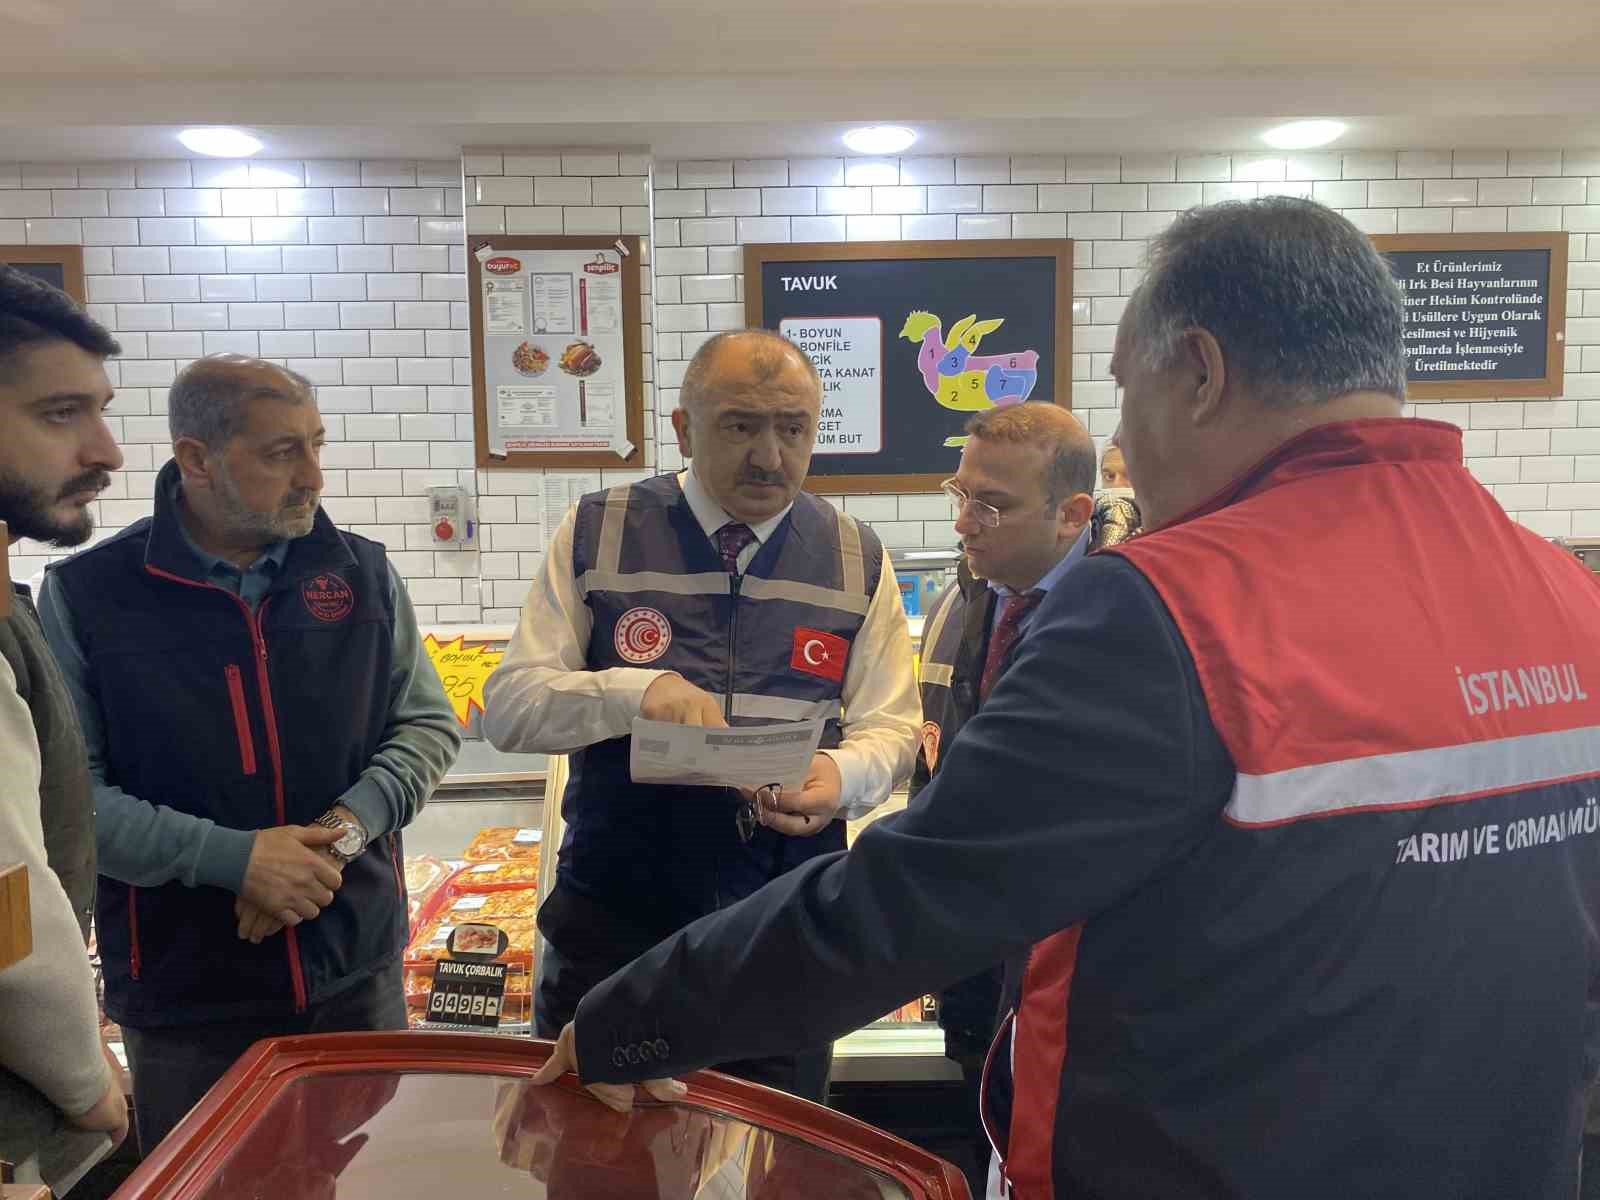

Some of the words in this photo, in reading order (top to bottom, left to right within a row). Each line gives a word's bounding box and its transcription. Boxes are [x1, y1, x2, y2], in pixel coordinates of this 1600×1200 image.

[1416, 263, 1430, 273] Et
[1433, 260, 1503, 273] Ürünlerimiz
[780, 275, 839, 291] TAVUK
[1408, 279, 1428, 290] Irk
[1430, 278, 1455, 289] Besi
[1457, 277, 1539, 292] Hayvanlarının
[1429, 294, 1468, 306] Hekim
[1470, 293, 1544, 305] Kontrolünde
[1412, 311, 1459, 322] Usüllere
[1462, 311, 1499, 324] Uygun
[1501, 310, 1543, 321] Olarak
[800, 328, 842, 338] BOYUN
[1453, 328, 1467, 338] ve
[1469, 326, 1518, 340] Hijyenik
[968, 334, 976, 344] 4
[800, 340, 851, 351] BONFİLE
[1401, 344, 1453, 357] şullarda
[1455, 341, 1524, 357] İşlenmesiyle
[809, 353, 831, 365] CİK
[929, 349, 935, 359] 1
[951, 357, 958, 367] 3
[1009, 357, 1017, 367] 6
[1415, 358, 1498, 372] Üretilmektedir
[818, 368, 832, 378] TA
[836, 368, 875, 378] KANAT
[823, 381, 841, 392] LIK
[971, 379, 978, 389] 5
[999, 379, 1007, 389] 7
[951, 391, 958, 401] 2
[818, 421, 841, 431] GET
[839, 434, 862, 444] BUT
[1455, 664, 1588, 716] İSTANBUL
[1396, 829, 1468, 864] TARIM
[1473, 824, 1500, 855] VE
[440, 962, 465, 975] TAVUK
[465, 964, 503, 978] ÇORBALIK
